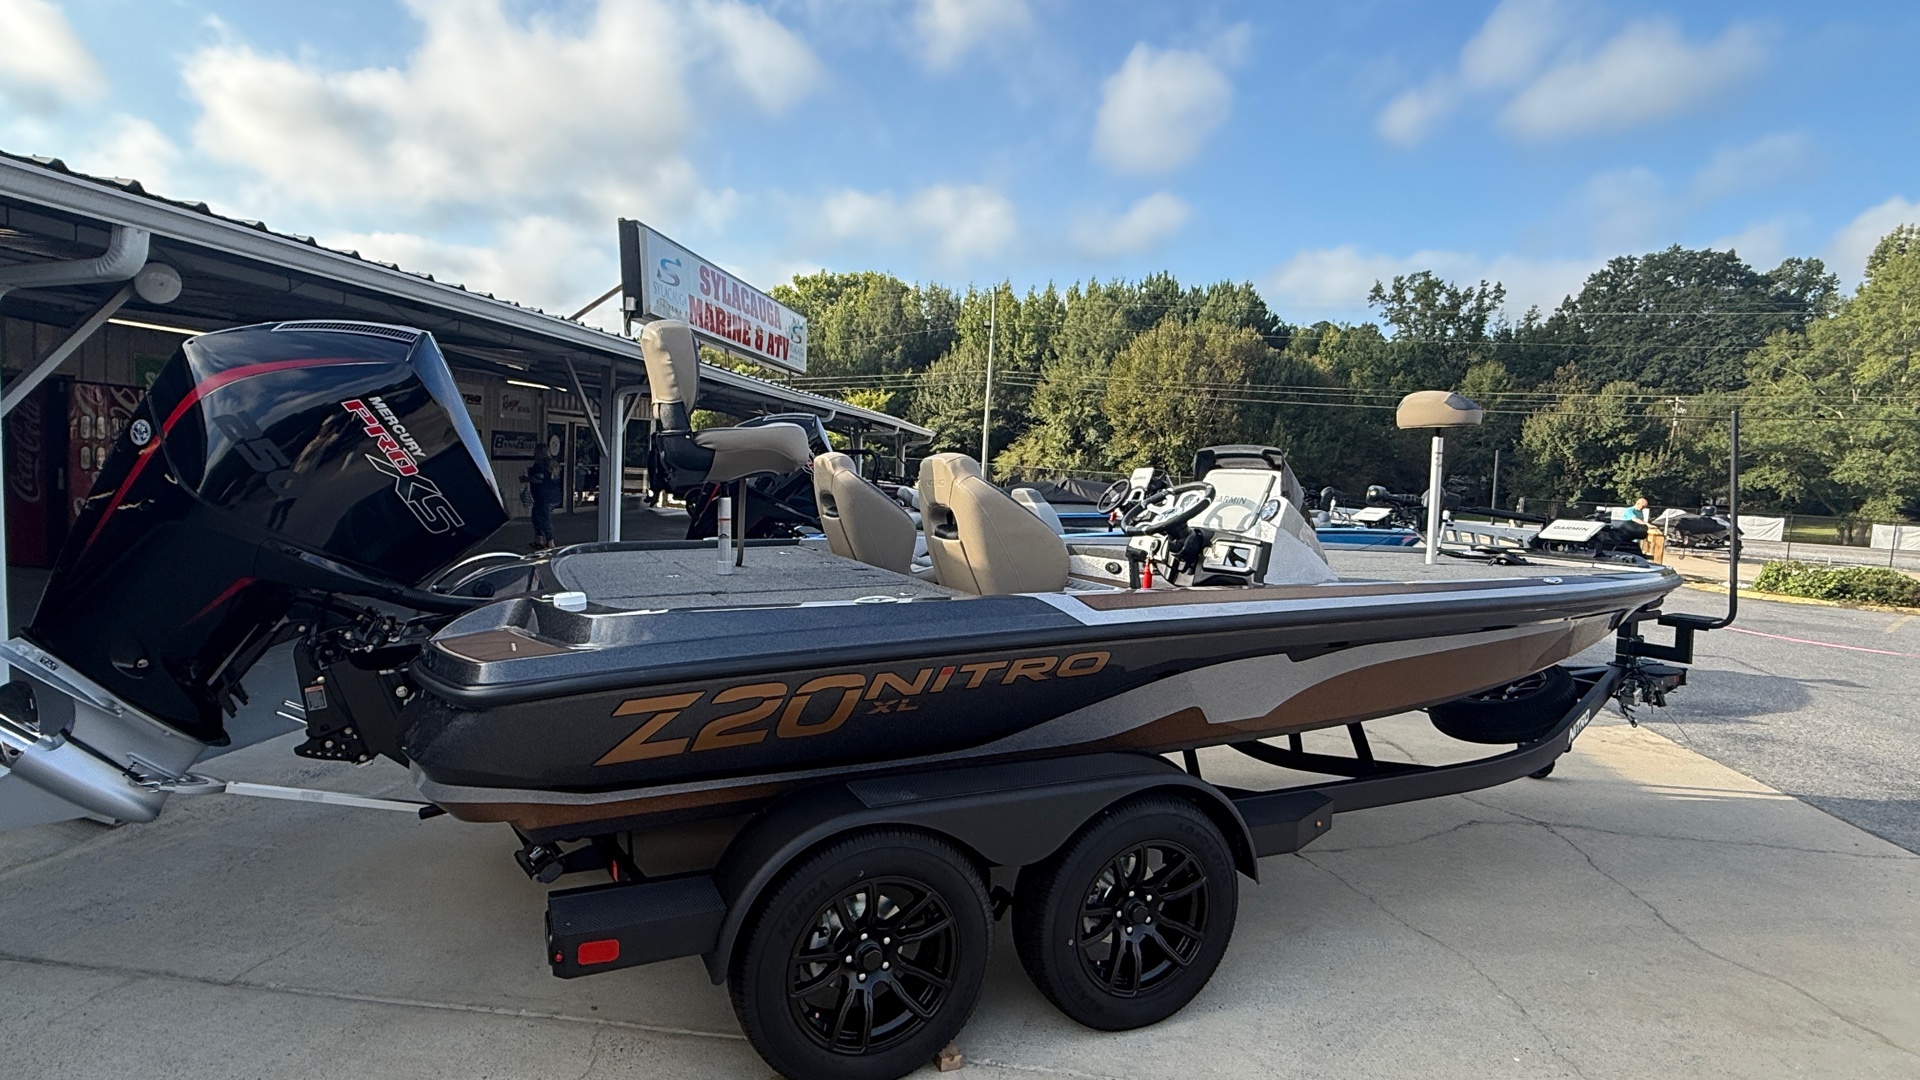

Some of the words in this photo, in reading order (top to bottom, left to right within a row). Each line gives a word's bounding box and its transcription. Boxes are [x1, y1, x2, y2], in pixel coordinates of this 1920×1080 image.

[688, 293, 752, 347] MARINE
[755, 324, 764, 351] &
[766, 332, 790, 361] ATV
[699, 264, 782, 331] SYLACAUGA
[341, 399, 419, 476] PRO
[368, 396, 426, 458] MERCURY
[365, 447, 465, 534] XS
[592, 673, 867, 767] Z20
[863, 651, 1111, 700] NITRO
[867, 698, 919, 715] XL
[1568, 708, 1590, 744] NITRO
